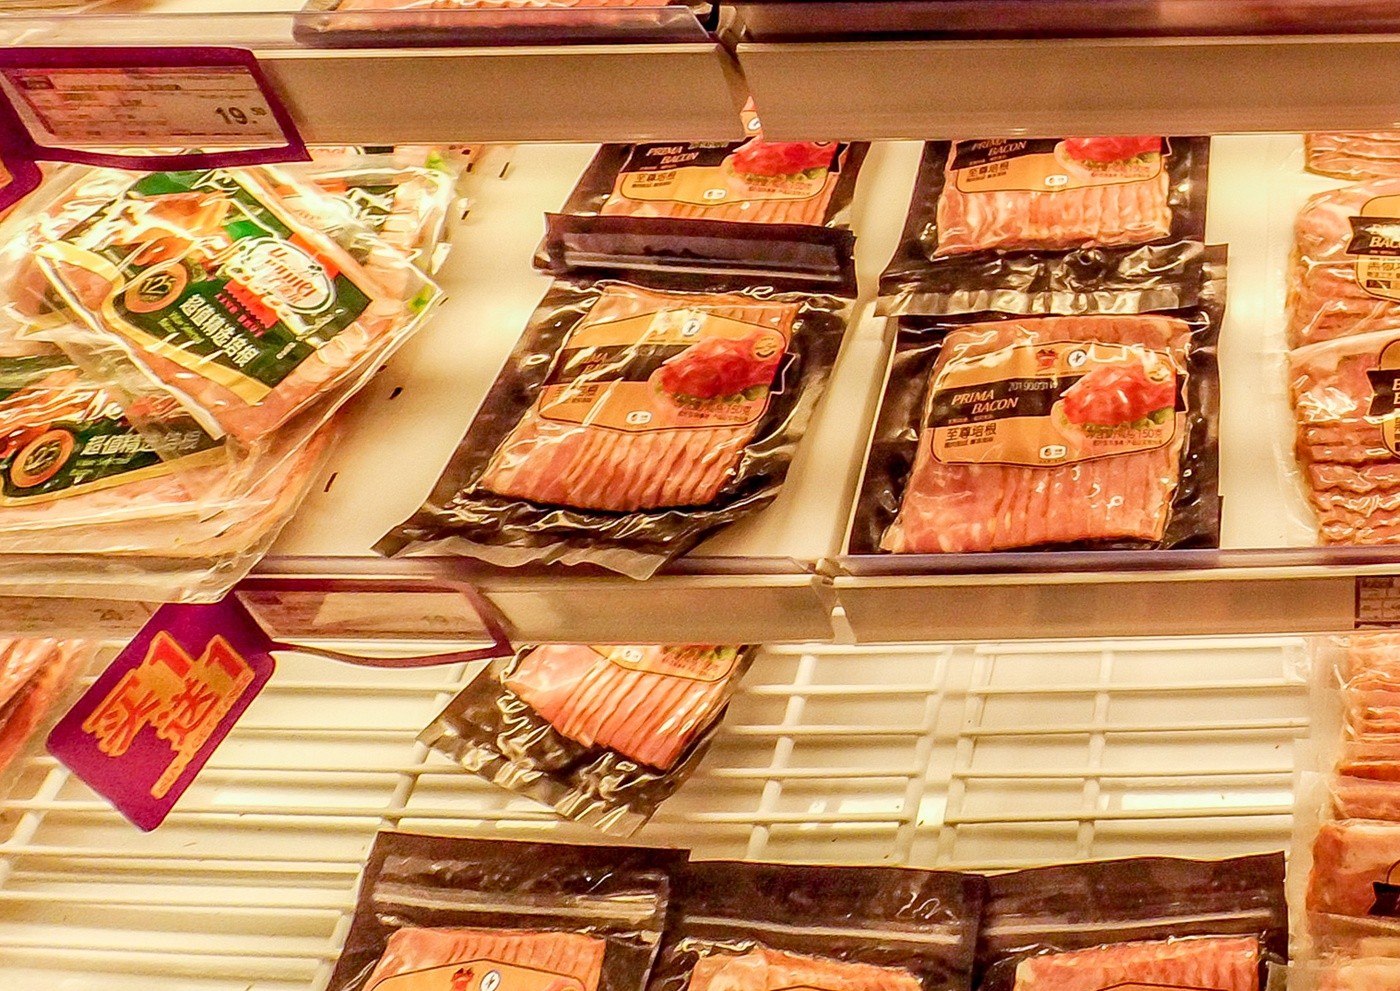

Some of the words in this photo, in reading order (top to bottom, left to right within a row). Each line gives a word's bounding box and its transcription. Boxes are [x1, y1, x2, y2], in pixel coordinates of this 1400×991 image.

[988, 140, 1027, 157] BACON
[178, 290, 261, 369] 超值精选培根
[951, 389, 995, 406] PRIMA
[971, 396, 1019, 415] BACON
[83, 631, 196, 757] 买1
[149, 638, 249, 749] 送1
